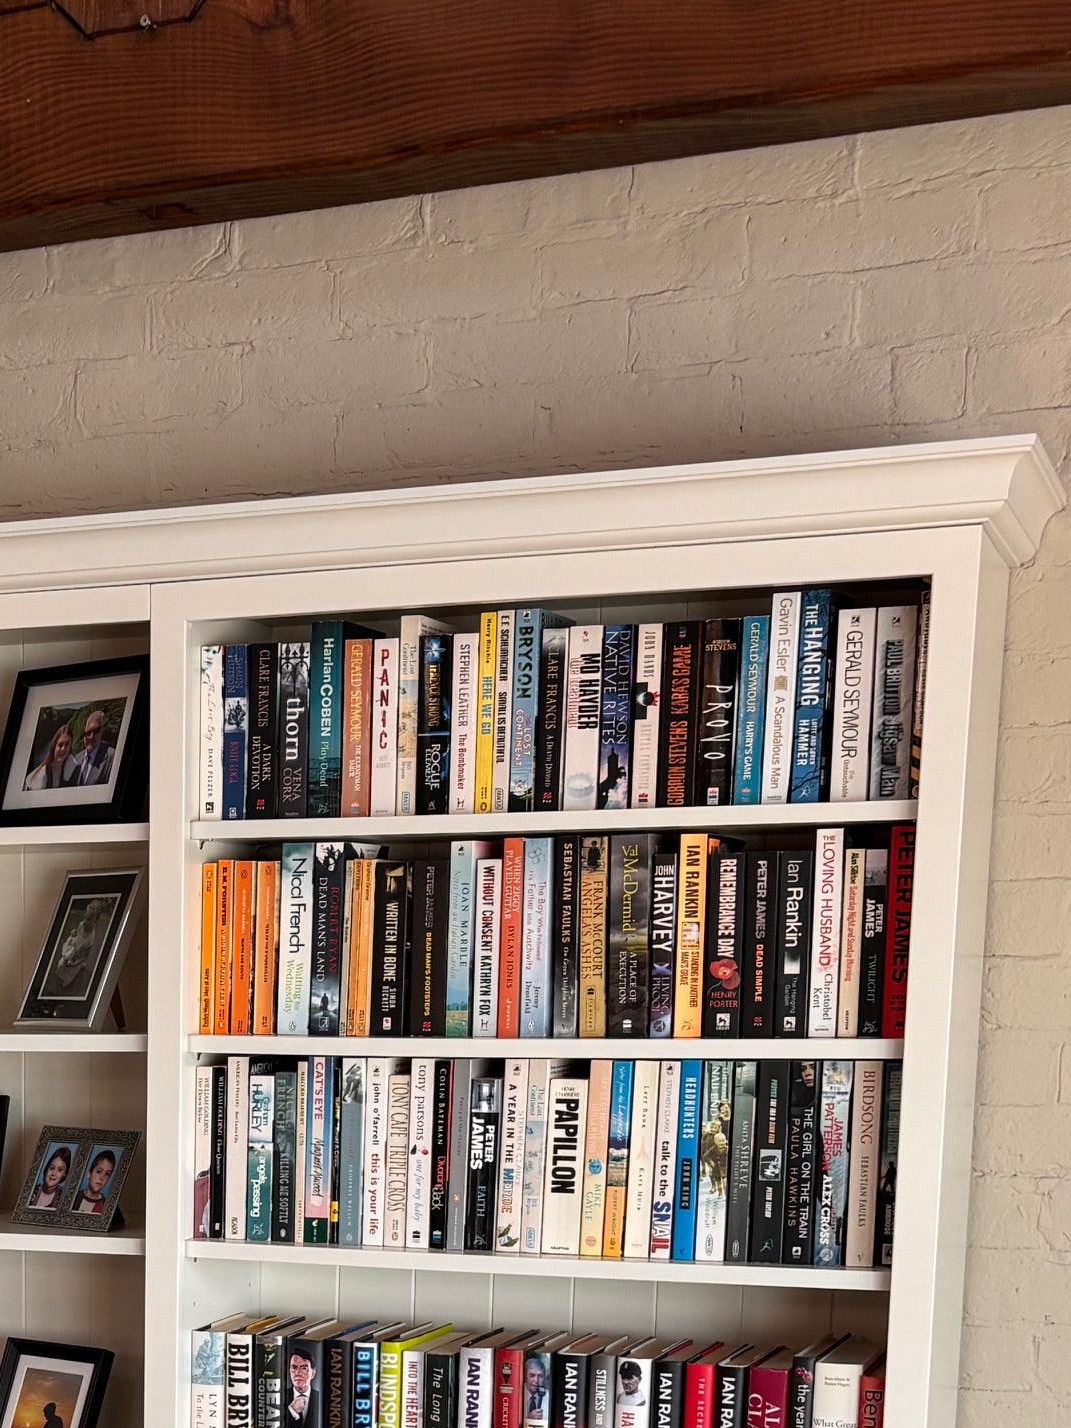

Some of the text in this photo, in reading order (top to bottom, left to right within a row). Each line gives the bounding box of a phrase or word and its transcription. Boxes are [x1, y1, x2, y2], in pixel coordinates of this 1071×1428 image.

[516, 626, 533, 698] BRYSON
[800, 604, 823, 705] THE HANGING
[257, 650, 270, 727] CLARE FRANCIS
[319, 638, 335, 787] Harlan COBEN Play Dead
[350, 644, 363, 741] GERALD SEYMOUR
[481, 676, 493, 735] HERE WE GO
[602, 632, 618, 744] NATIVE RITES
[616, 630, 631, 744] DAVID HEWSON
[770, 598, 792, 789] Gavin Esler A Scandalous Man
[285, 697, 304, 761] thorn
[700, 684, 734, 759] PROVO
[797, 719, 810, 765] HAMMER
[289, 858, 308, 953] Nicci French
[622, 858, 639, 932] McDermid
[685, 846, 700, 918] IAN RANKIN
[717, 859, 737, 958] REMEMBRANCE DAY
[757, 860, 767, 897] PETER
[785, 860, 803, 947] Ian Rankin
[819, 842, 836, 965] LOVING HUSBAND
[383, 901, 398, 982] WRITTEN IN BONE
[479, 865, 495, 1016] WITHOUT CONSENT KATHRYN FOX
[755, 900, 766, 938] JAMES
[755, 970, 763, 1002] SIMPLE
[372, 1083, 380, 1103] john
[682, 1077, 697, 1138] HEADHUNTERS
[372, 1108, 380, 1145] o'farrell
[470, 1117, 484, 1169] JAMES
[484, 1125, 496, 1162] PETER
[550, 1099, 579, 1194] PAPILLON
[858, 1071, 876, 1227] BIRDSONG SEBASTIAN FAULKS
[371, 1153, 379, 1173] this
[788, 1119, 800, 1226] PAULA HAWKINS
[798, 1107, 813, 1238] THE GIRL ON THE TRAIN
[369, 1190, 377, 1214] your
[369, 1218, 378, 1235] life
[228, 1343, 249, 1387] BILL
[330, 1349, 342, 1374] IAN
[356, 1351, 370, 1392] BILL
[467, 1358, 481, 1386] IAN
[721, 1377, 735, 1404] IAN
[208, 1394, 217, 1418] LYN
[797, 1385, 810, 1403] the
[863, 1390, 883, 1428] Ben
